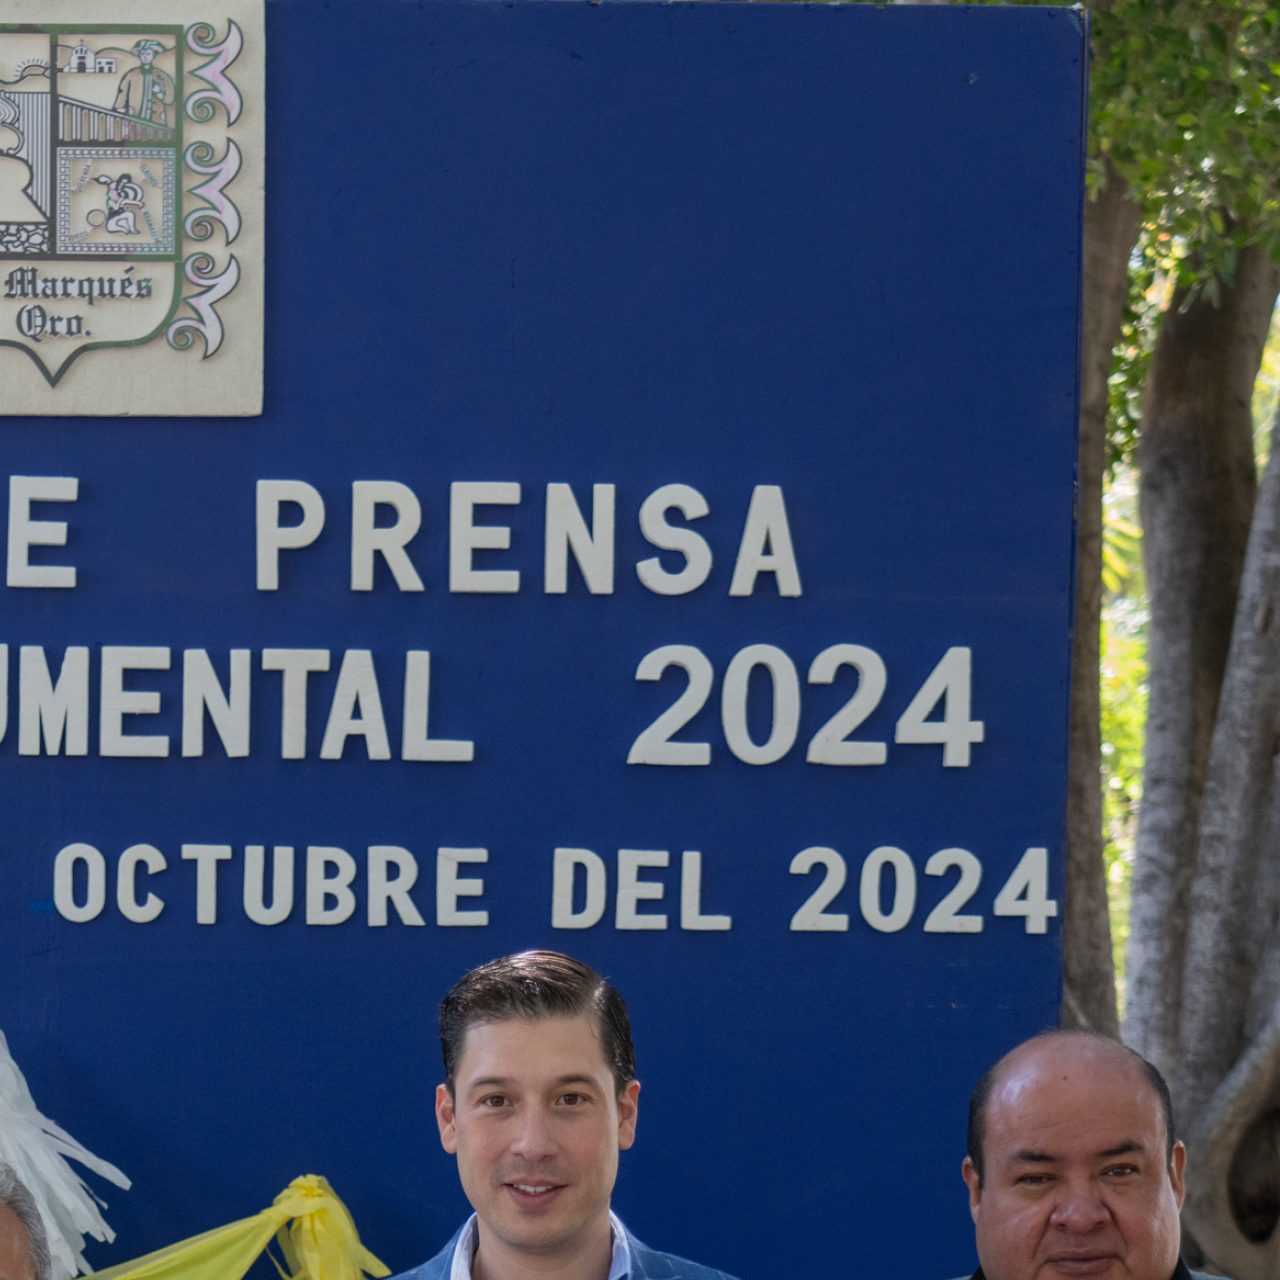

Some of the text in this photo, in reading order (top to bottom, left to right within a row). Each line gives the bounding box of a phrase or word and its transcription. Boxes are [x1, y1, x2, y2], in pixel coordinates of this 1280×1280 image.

[3, 265, 152, 305] Marqués
[16, 304, 91, 342] Qro.
[256, 479, 802, 596] PRENSA
[627, 643, 984, 767] 2024
[54, 843, 488, 926] OCTUBRE
[552, 847, 731, 930] DEL
[789, 846, 1057, 934] 2024
